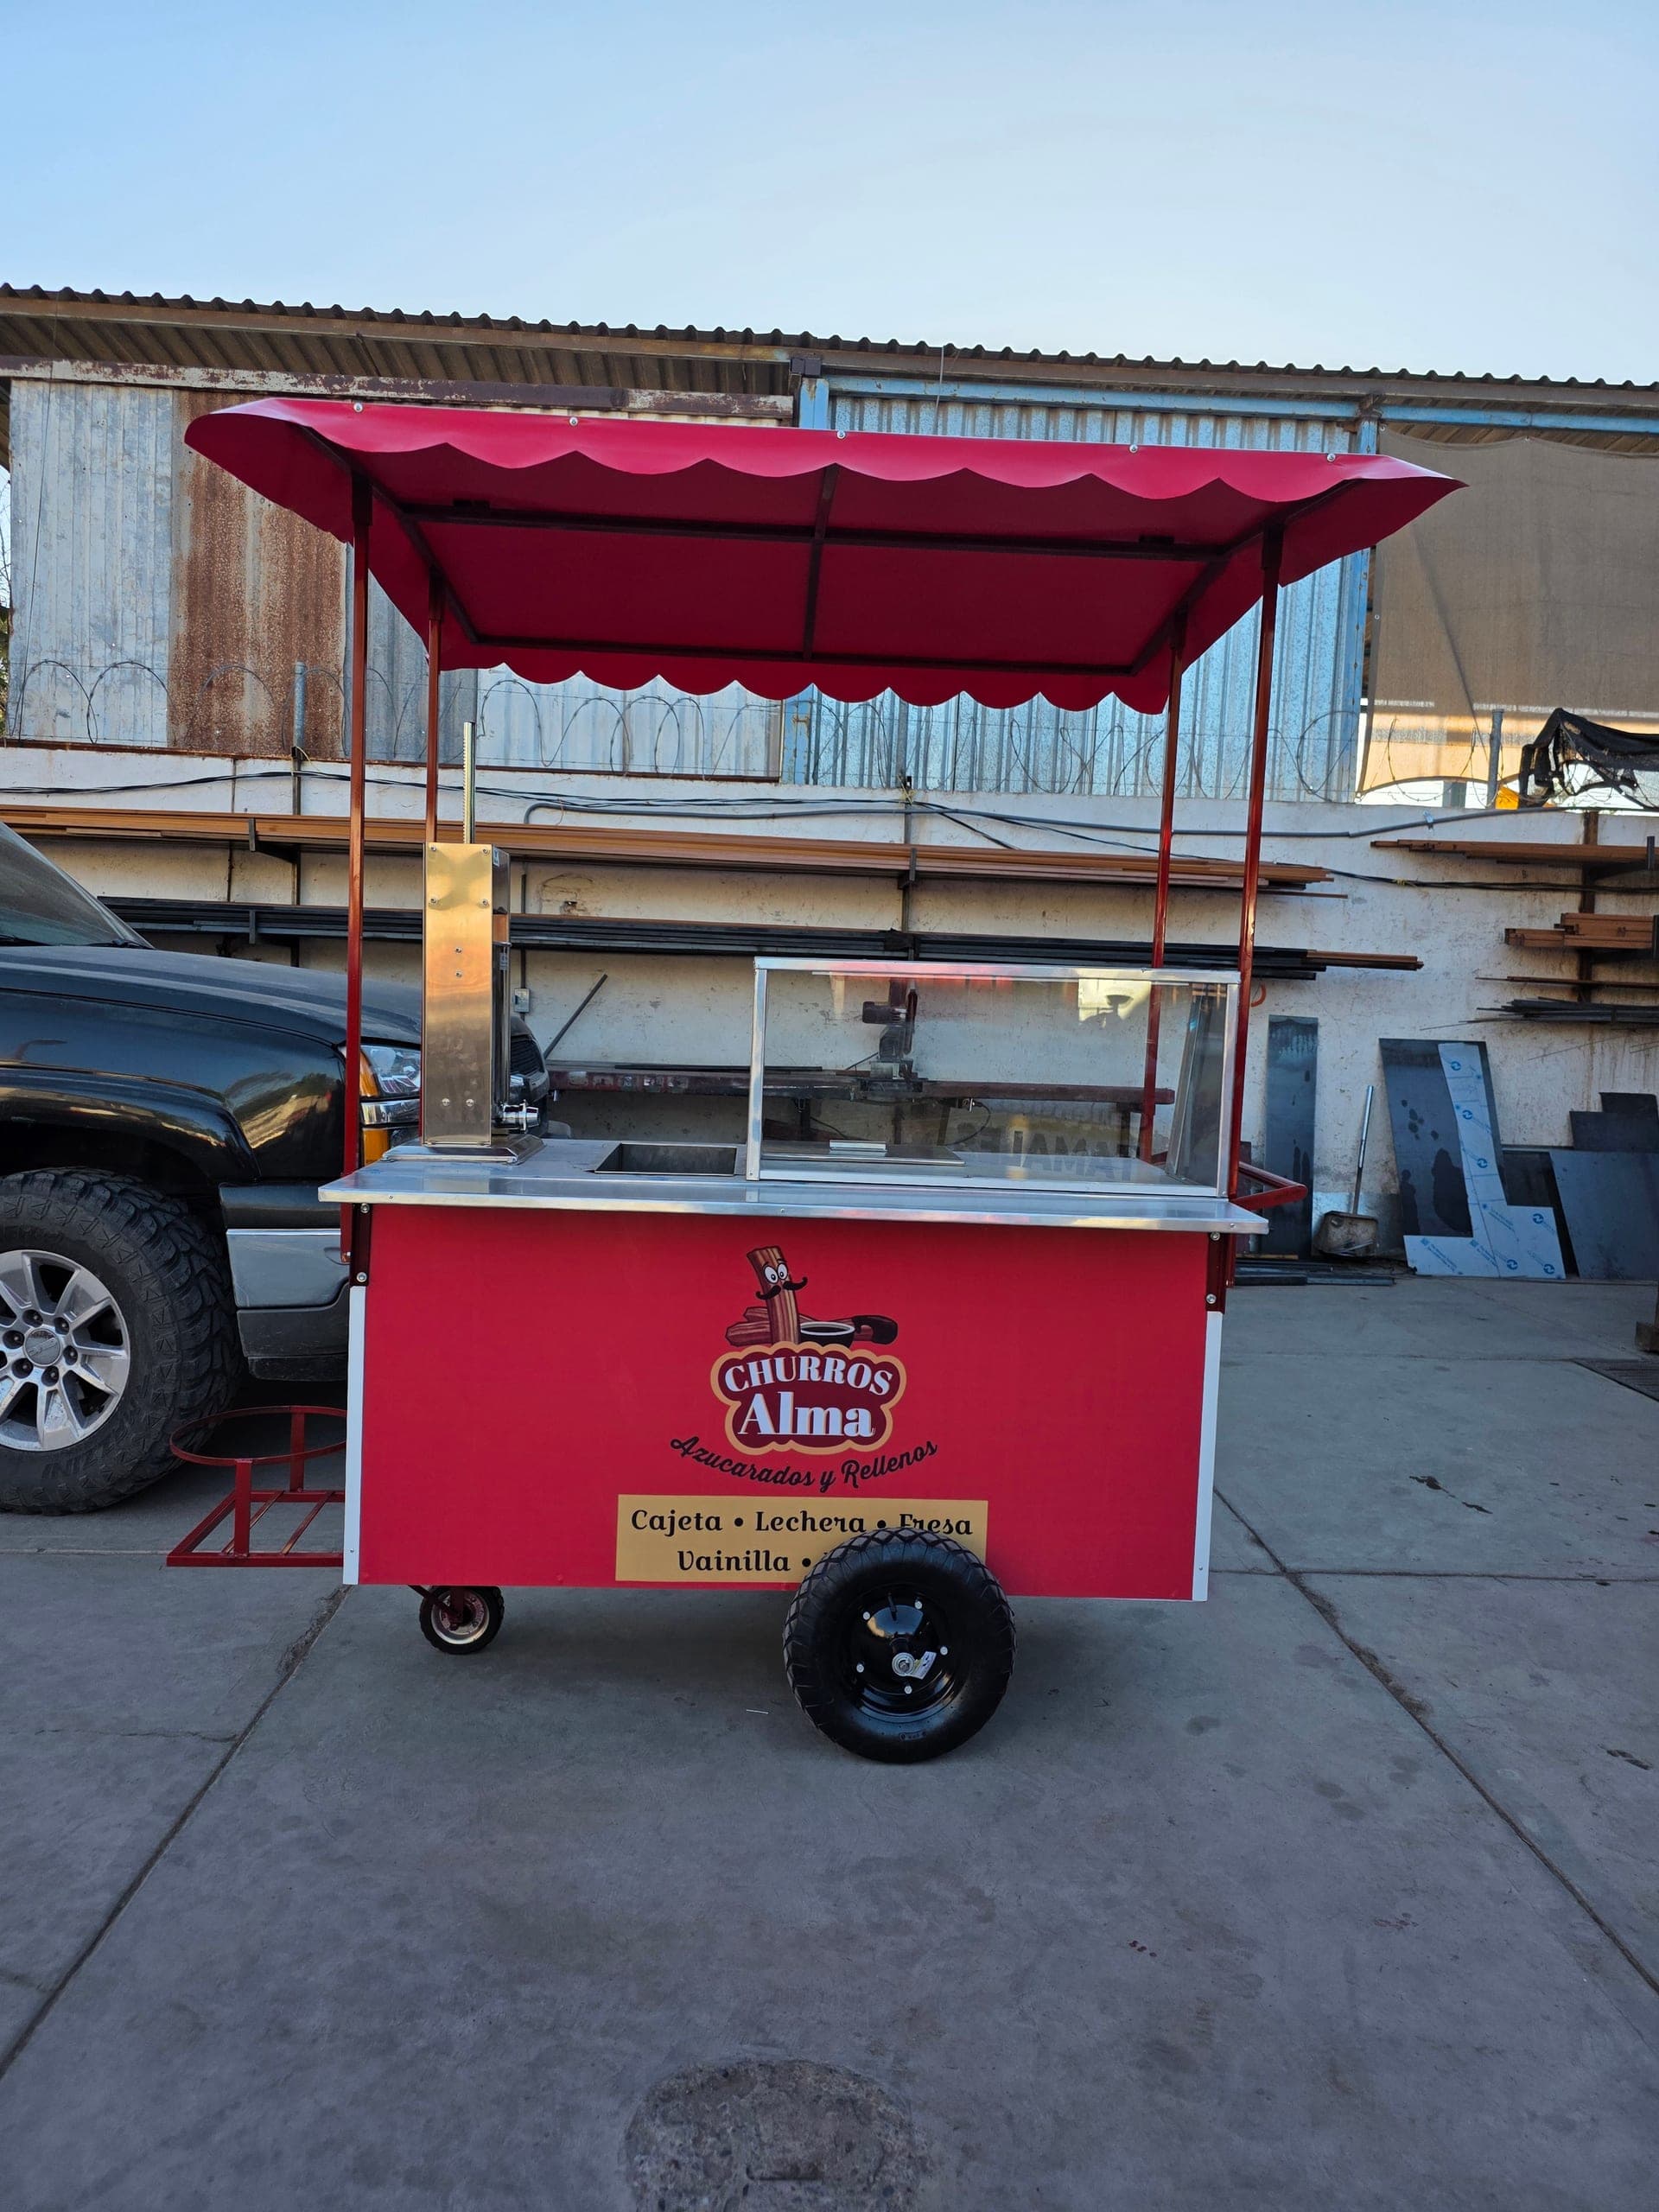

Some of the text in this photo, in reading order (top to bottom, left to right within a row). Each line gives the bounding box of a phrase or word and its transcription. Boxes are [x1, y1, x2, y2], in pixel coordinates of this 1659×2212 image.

[724, 1356, 893, 1395] CHURROS
[738, 1391, 875, 1438] Alma
[670, 1436, 938, 1493] Azucarados y Rellenos
[631, 1510, 973, 1537] Cajeta Lechera Fresa
[677, 1550, 791, 1572] Vainilla
